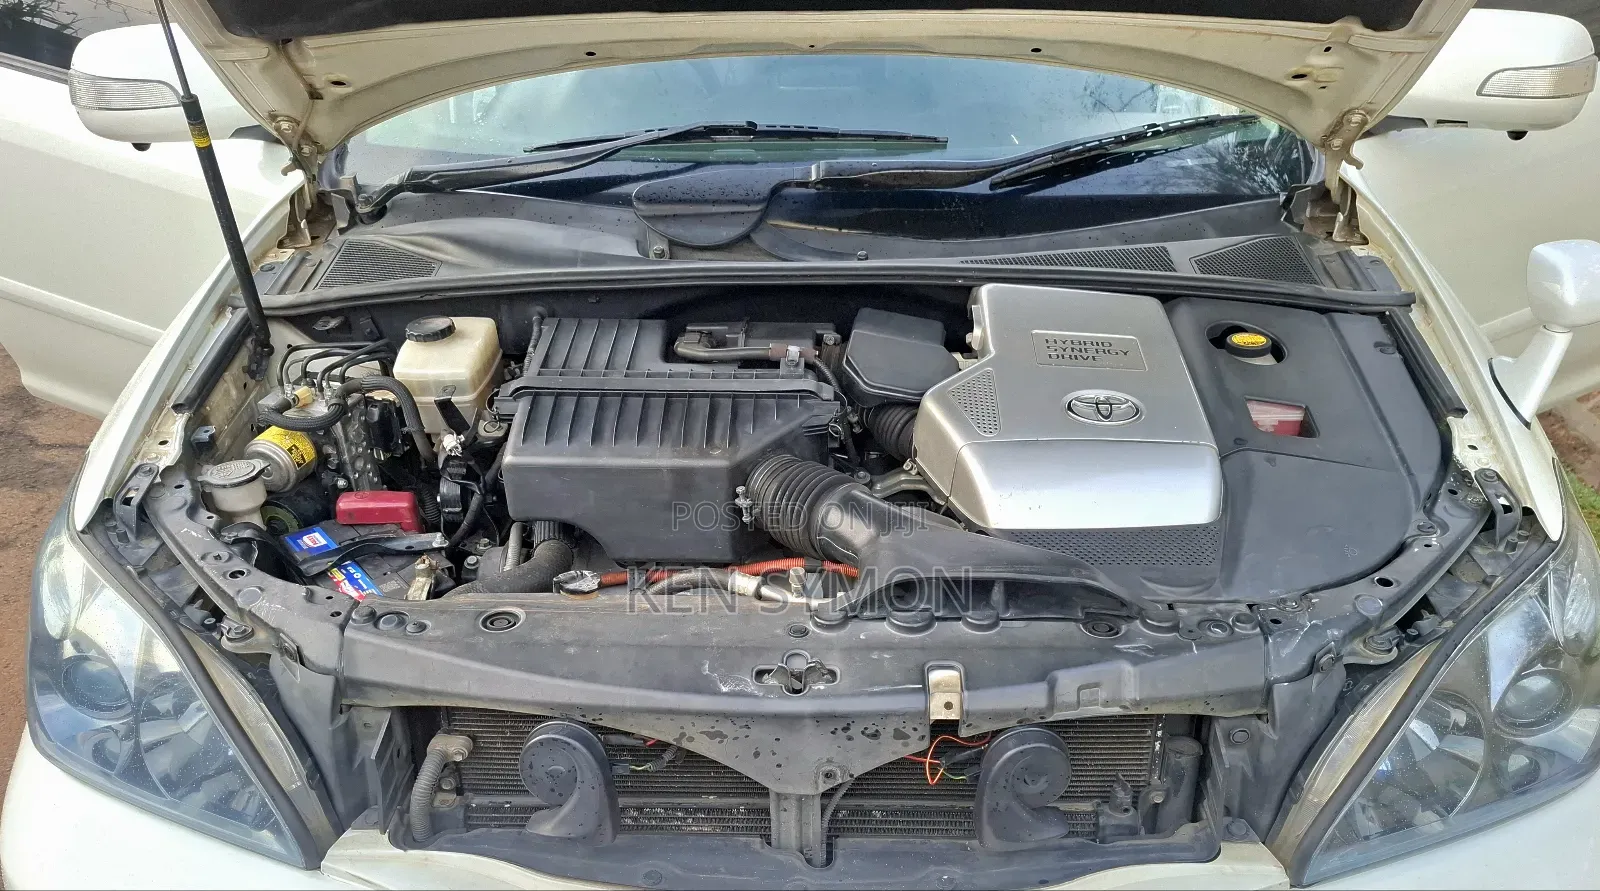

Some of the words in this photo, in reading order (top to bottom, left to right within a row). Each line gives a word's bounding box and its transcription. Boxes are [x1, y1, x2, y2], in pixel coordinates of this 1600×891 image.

[1045, 338, 1113, 348] HYBRID
[1046, 345, 1130, 356] SYNERGY
[1048, 353, 1103, 362] DRIVE
